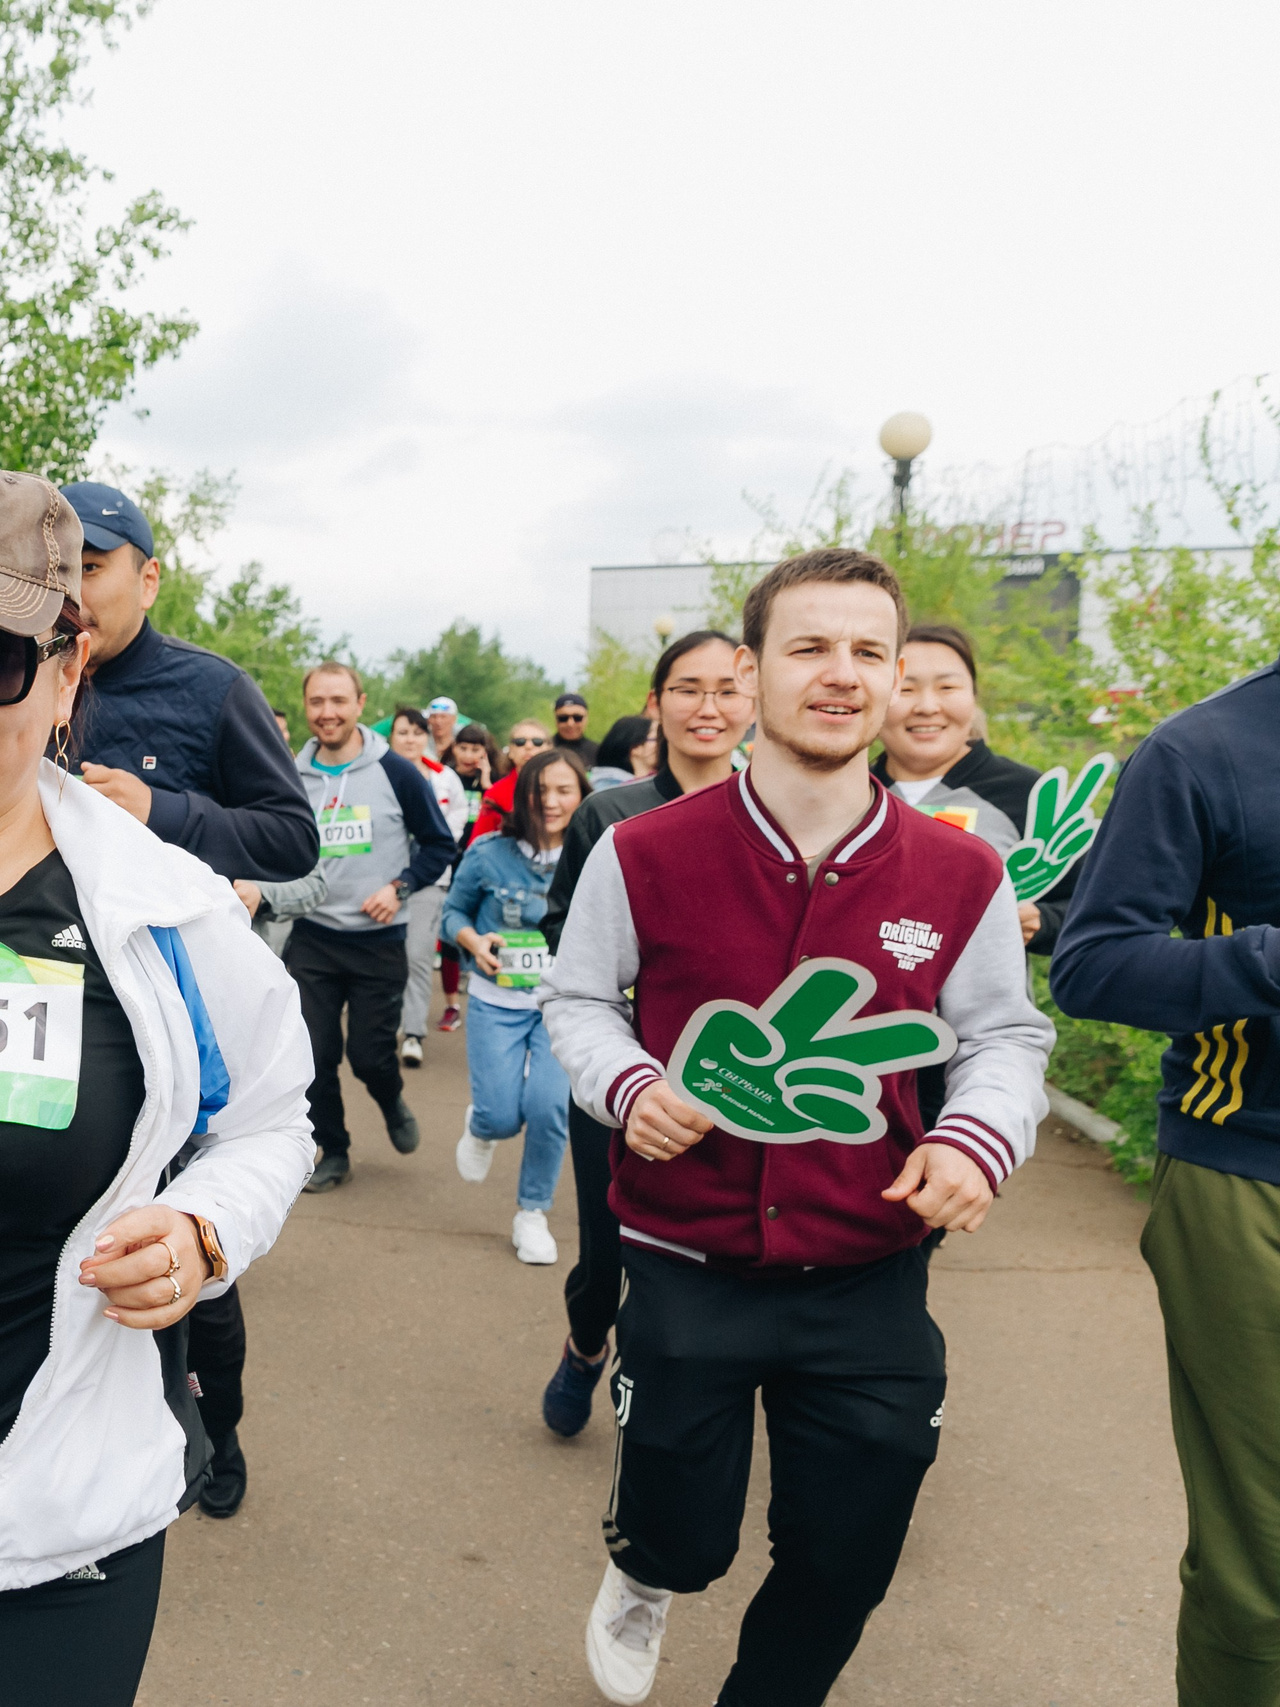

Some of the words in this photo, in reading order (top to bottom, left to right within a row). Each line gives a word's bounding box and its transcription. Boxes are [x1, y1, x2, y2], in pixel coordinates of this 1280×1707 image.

[325, 825, 363, 841] 0701
[879, 921, 943, 950] ORIGINAL
[51, 938, 86, 950] adidas
[718, 1067, 776, 1103] СБЕРБАНК
[65, 1571, 106, 1580] adidas
